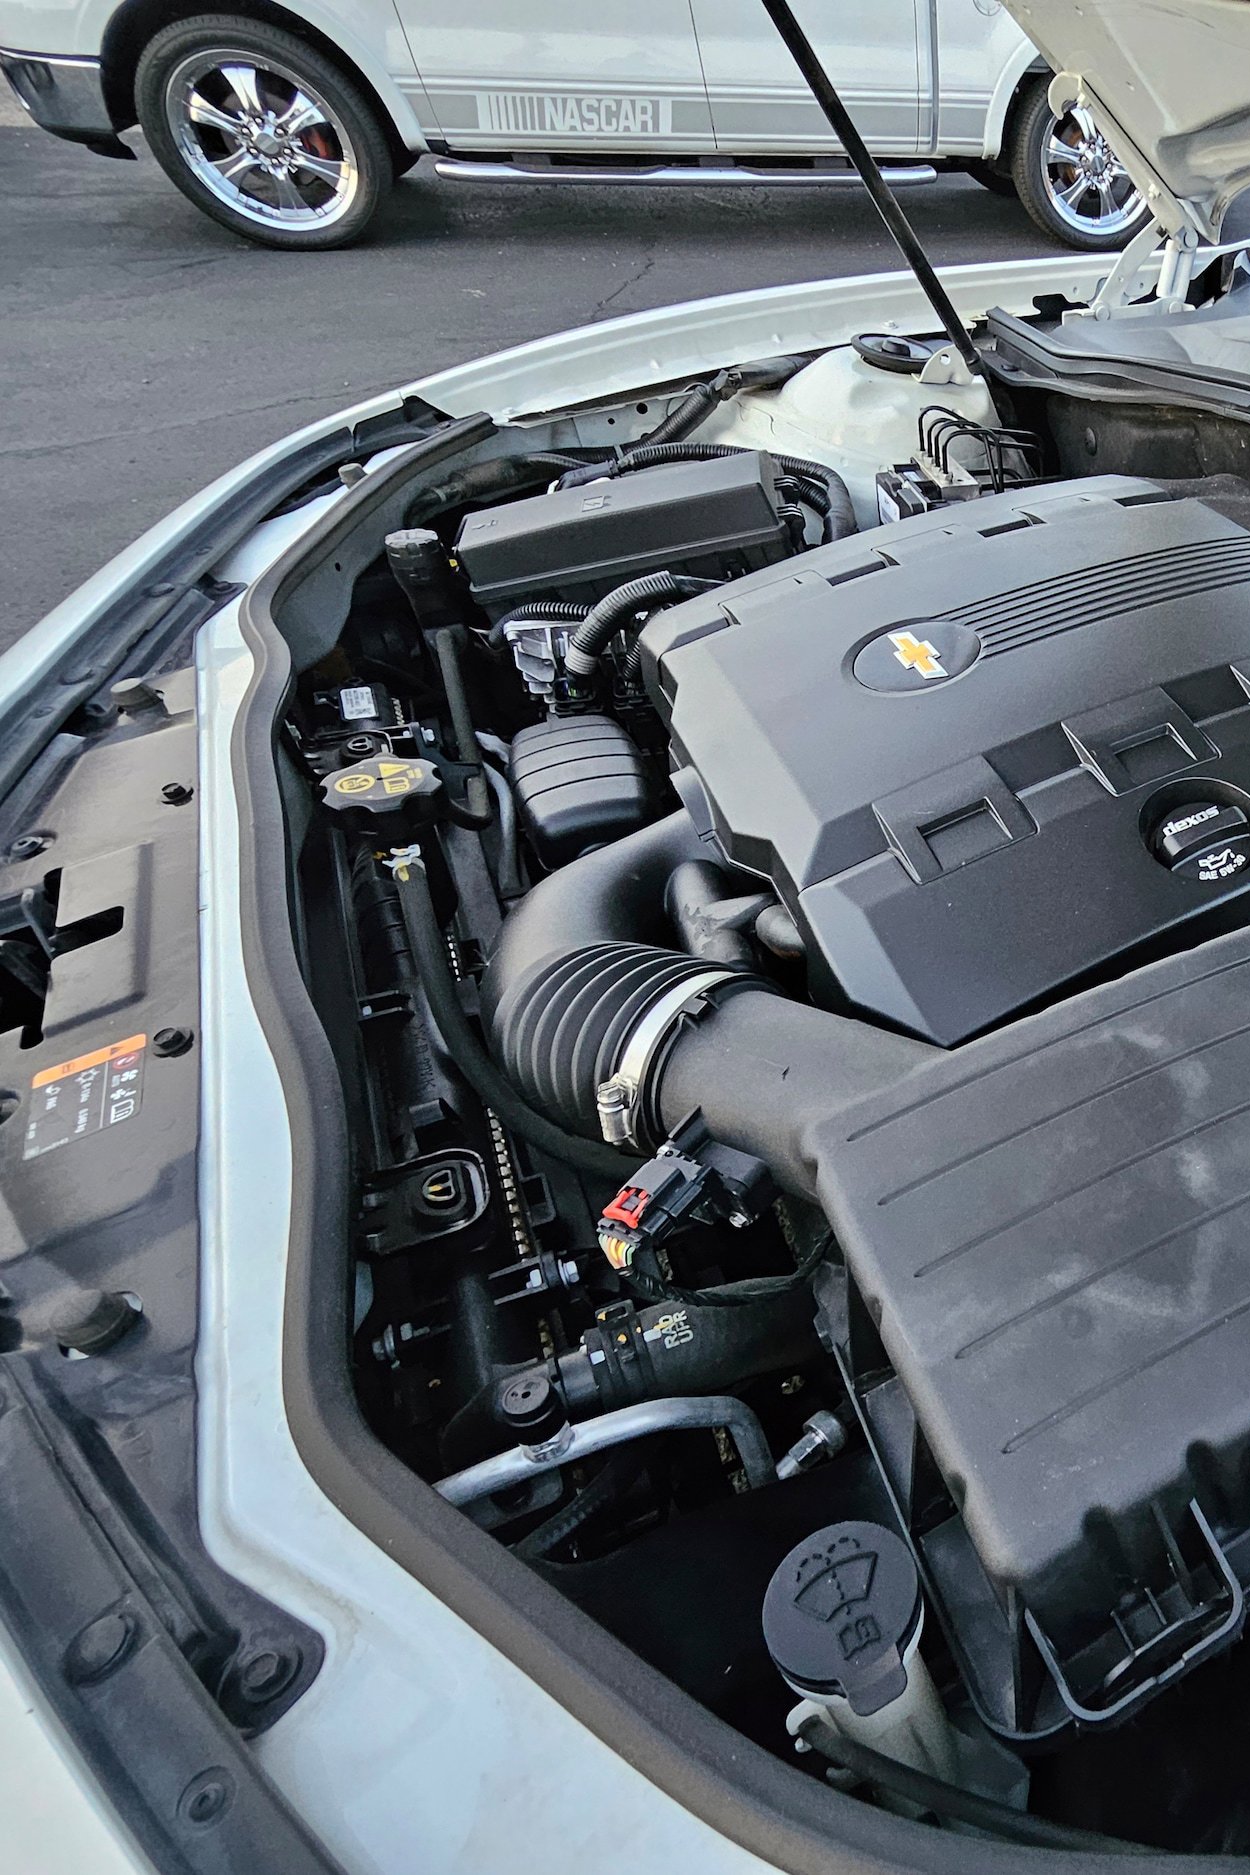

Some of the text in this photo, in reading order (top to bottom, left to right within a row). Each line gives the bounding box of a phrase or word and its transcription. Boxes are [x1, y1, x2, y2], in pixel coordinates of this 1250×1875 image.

[543, 96, 654, 133] NASCAR
[1162, 805, 1220, 837] dexos
[1198, 870, 1219, 881] SAE
[658, 1314, 681, 1349] RAD
